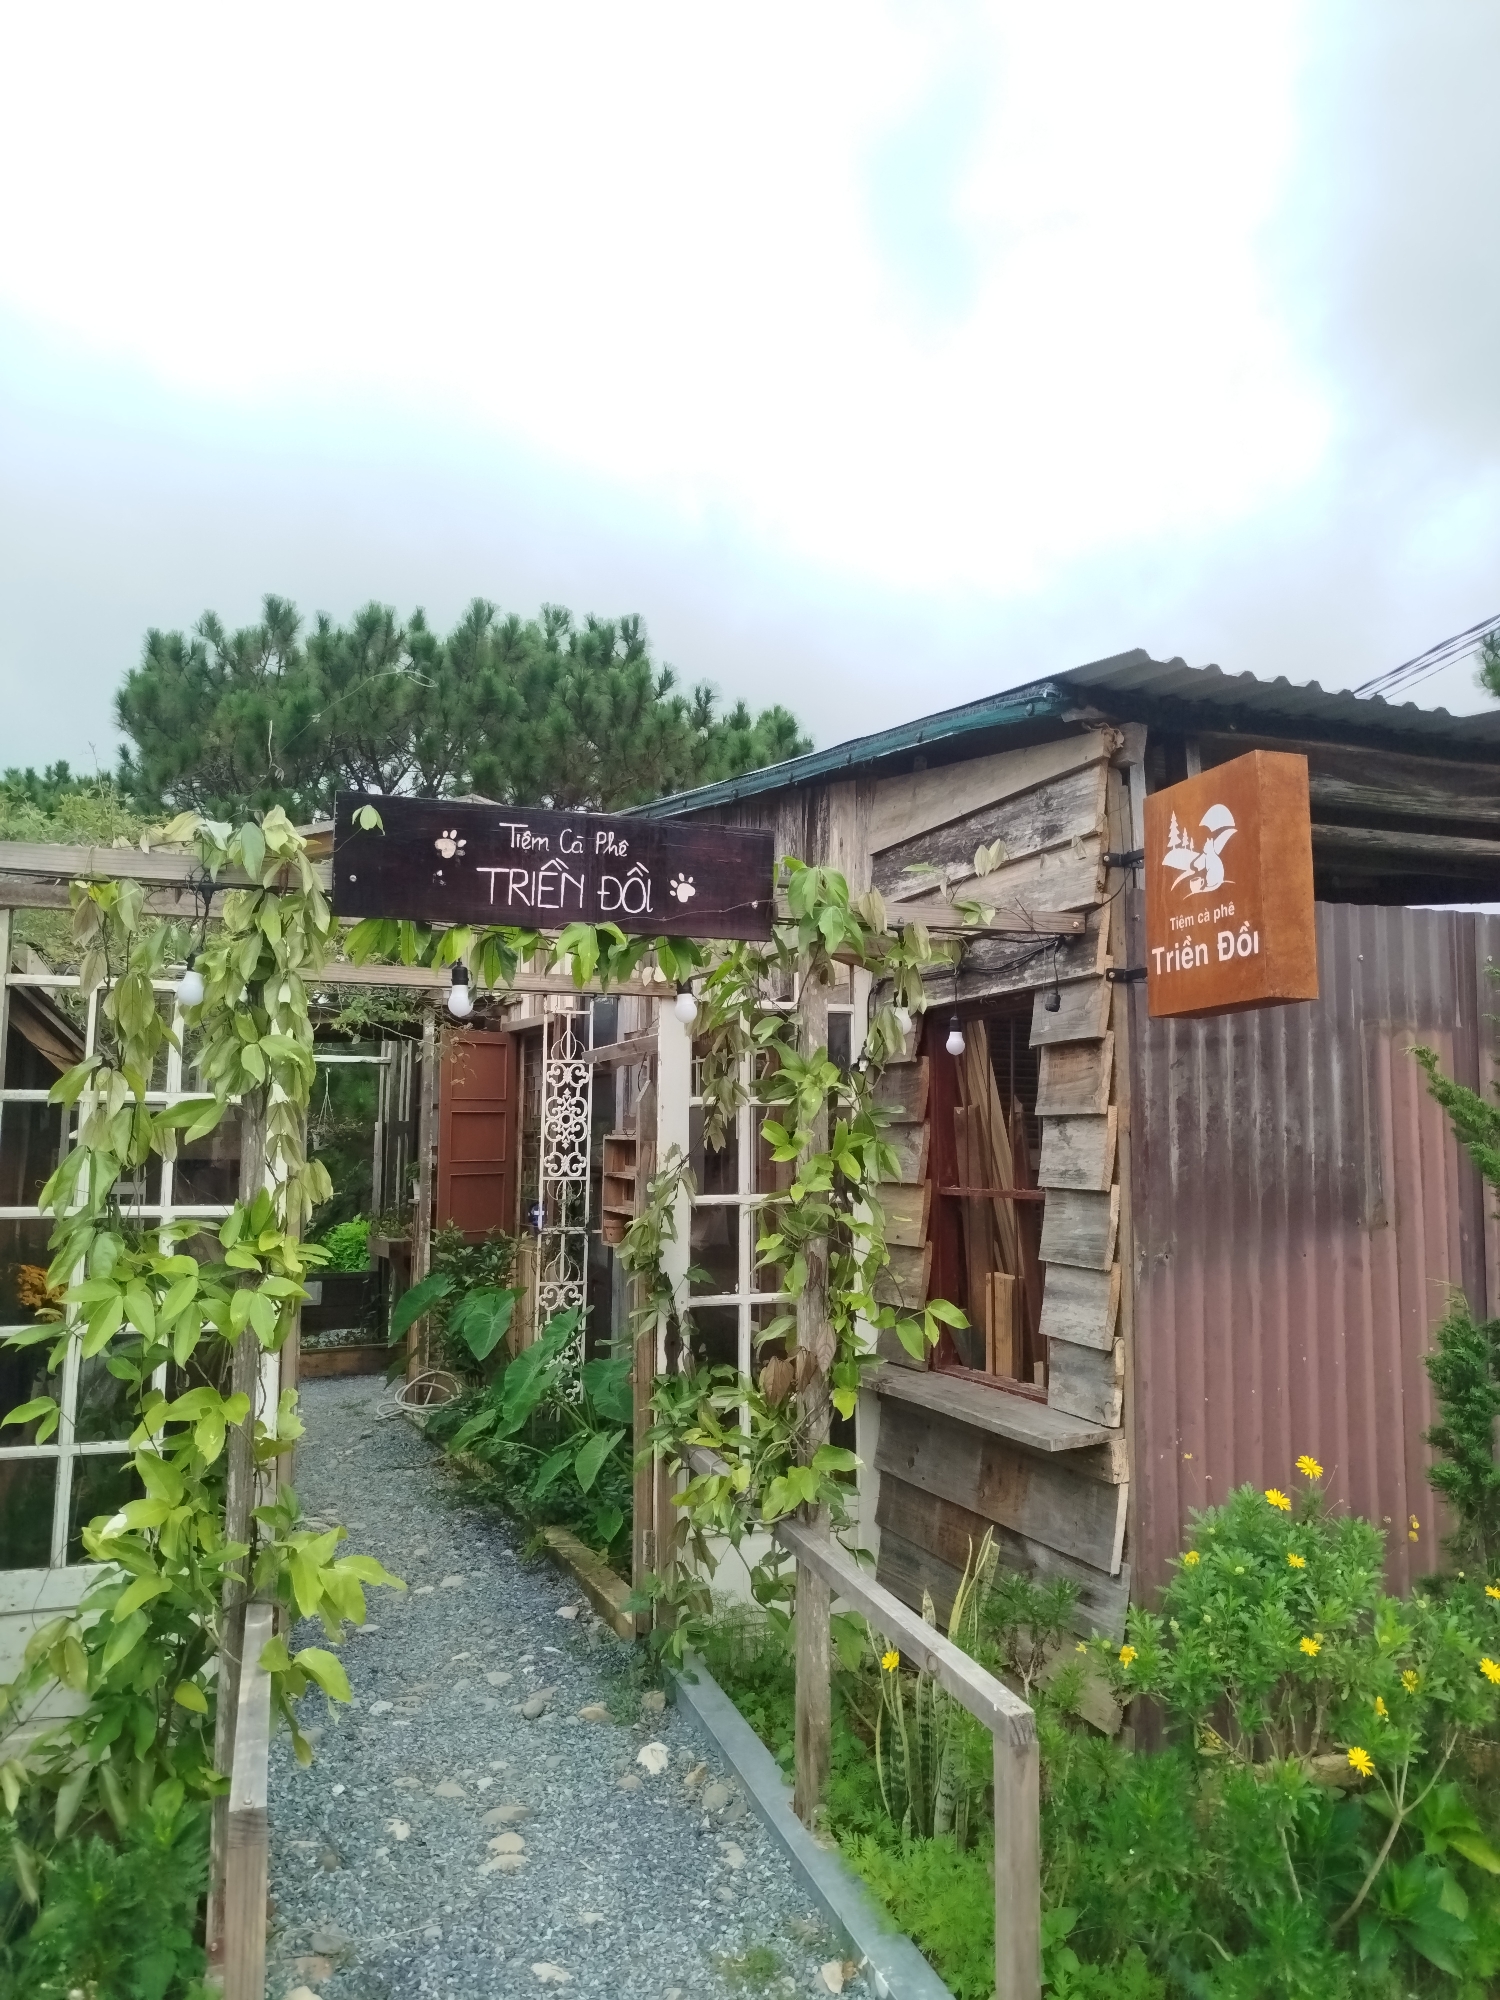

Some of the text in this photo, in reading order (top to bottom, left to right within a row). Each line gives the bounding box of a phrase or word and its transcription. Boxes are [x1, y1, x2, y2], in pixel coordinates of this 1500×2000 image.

[559, 828, 584, 854] Cà
[595, 831, 629, 857] Phê
[476, 857, 585, 908] TRIỀN
[1169, 900, 1235, 931] Tiệm cà phê
[1151, 920, 1259, 975] Triền Đồi
